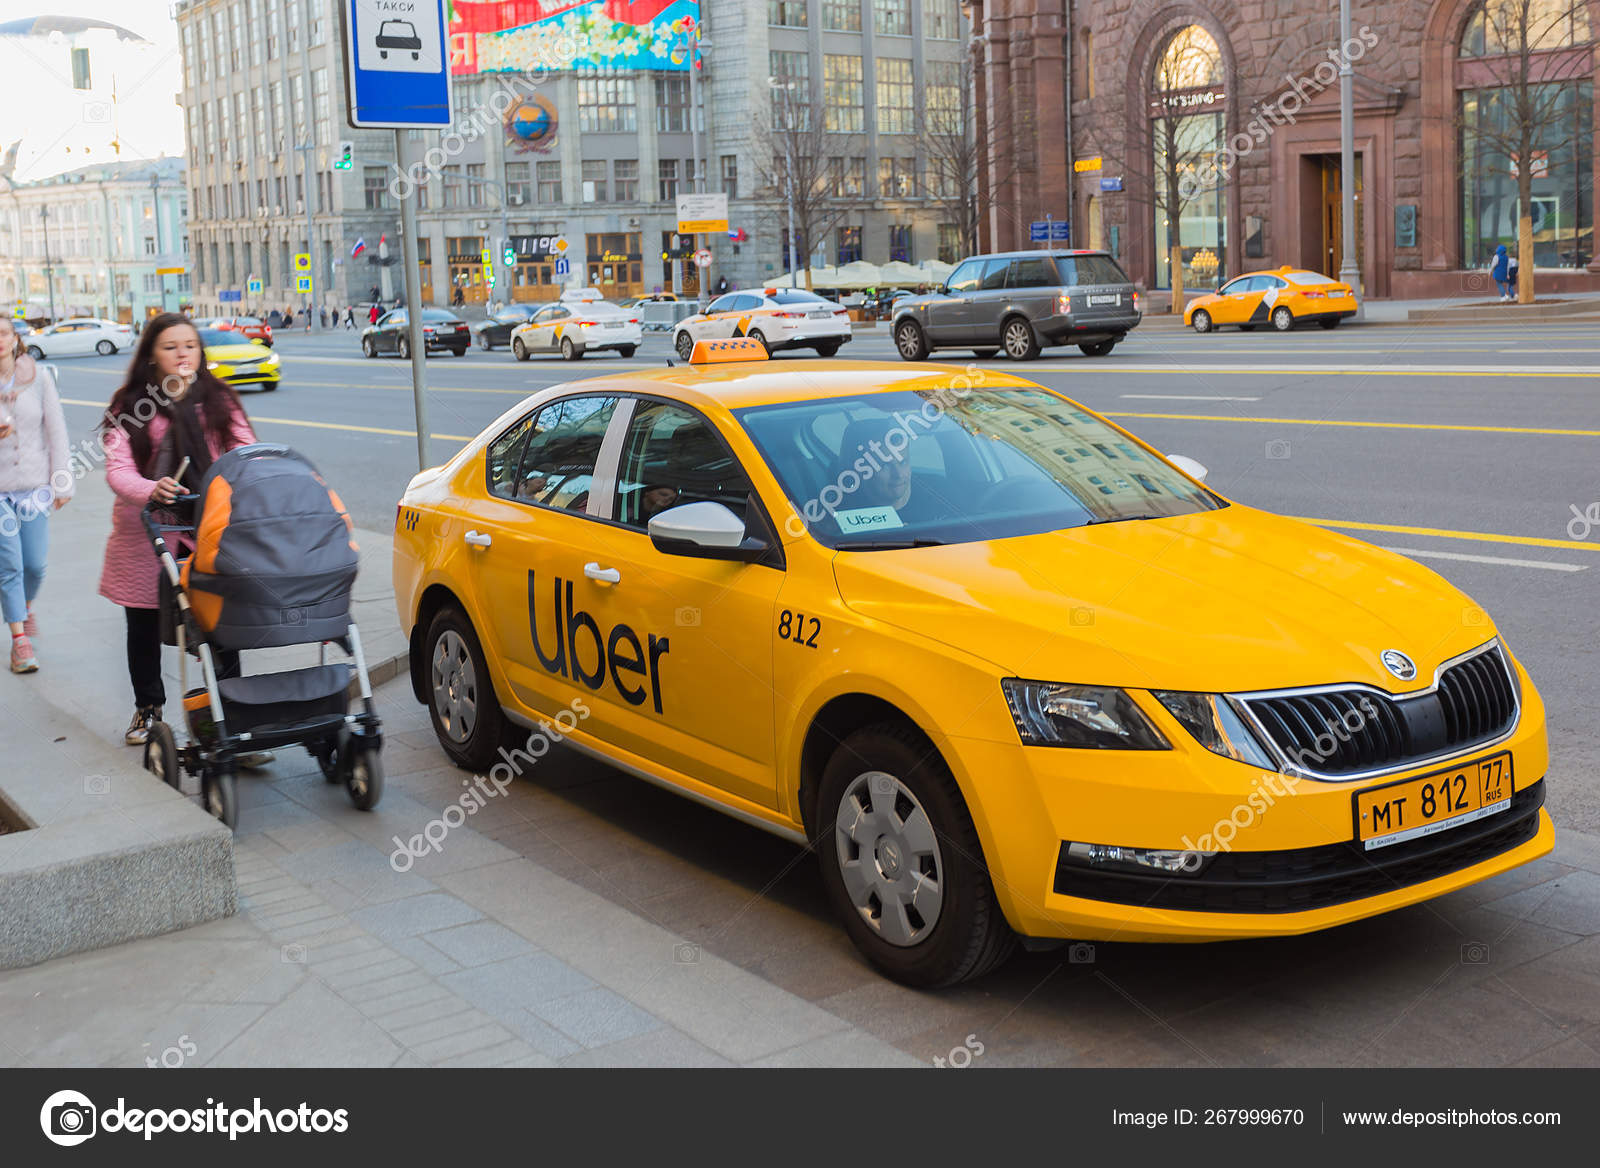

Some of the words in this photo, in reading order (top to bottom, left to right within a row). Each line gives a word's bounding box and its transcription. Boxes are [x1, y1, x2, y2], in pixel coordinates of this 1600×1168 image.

[376, 2, 415, 12] ТАКСИ
[846, 514, 887, 526] Uber
[528, 569, 669, 715] Uber
[778, 610, 821, 648] 812
[1481, 760, 1503, 791] 77
[1421, 774, 1469, 818] 812
[1486, 788, 1502, 802] RUS
